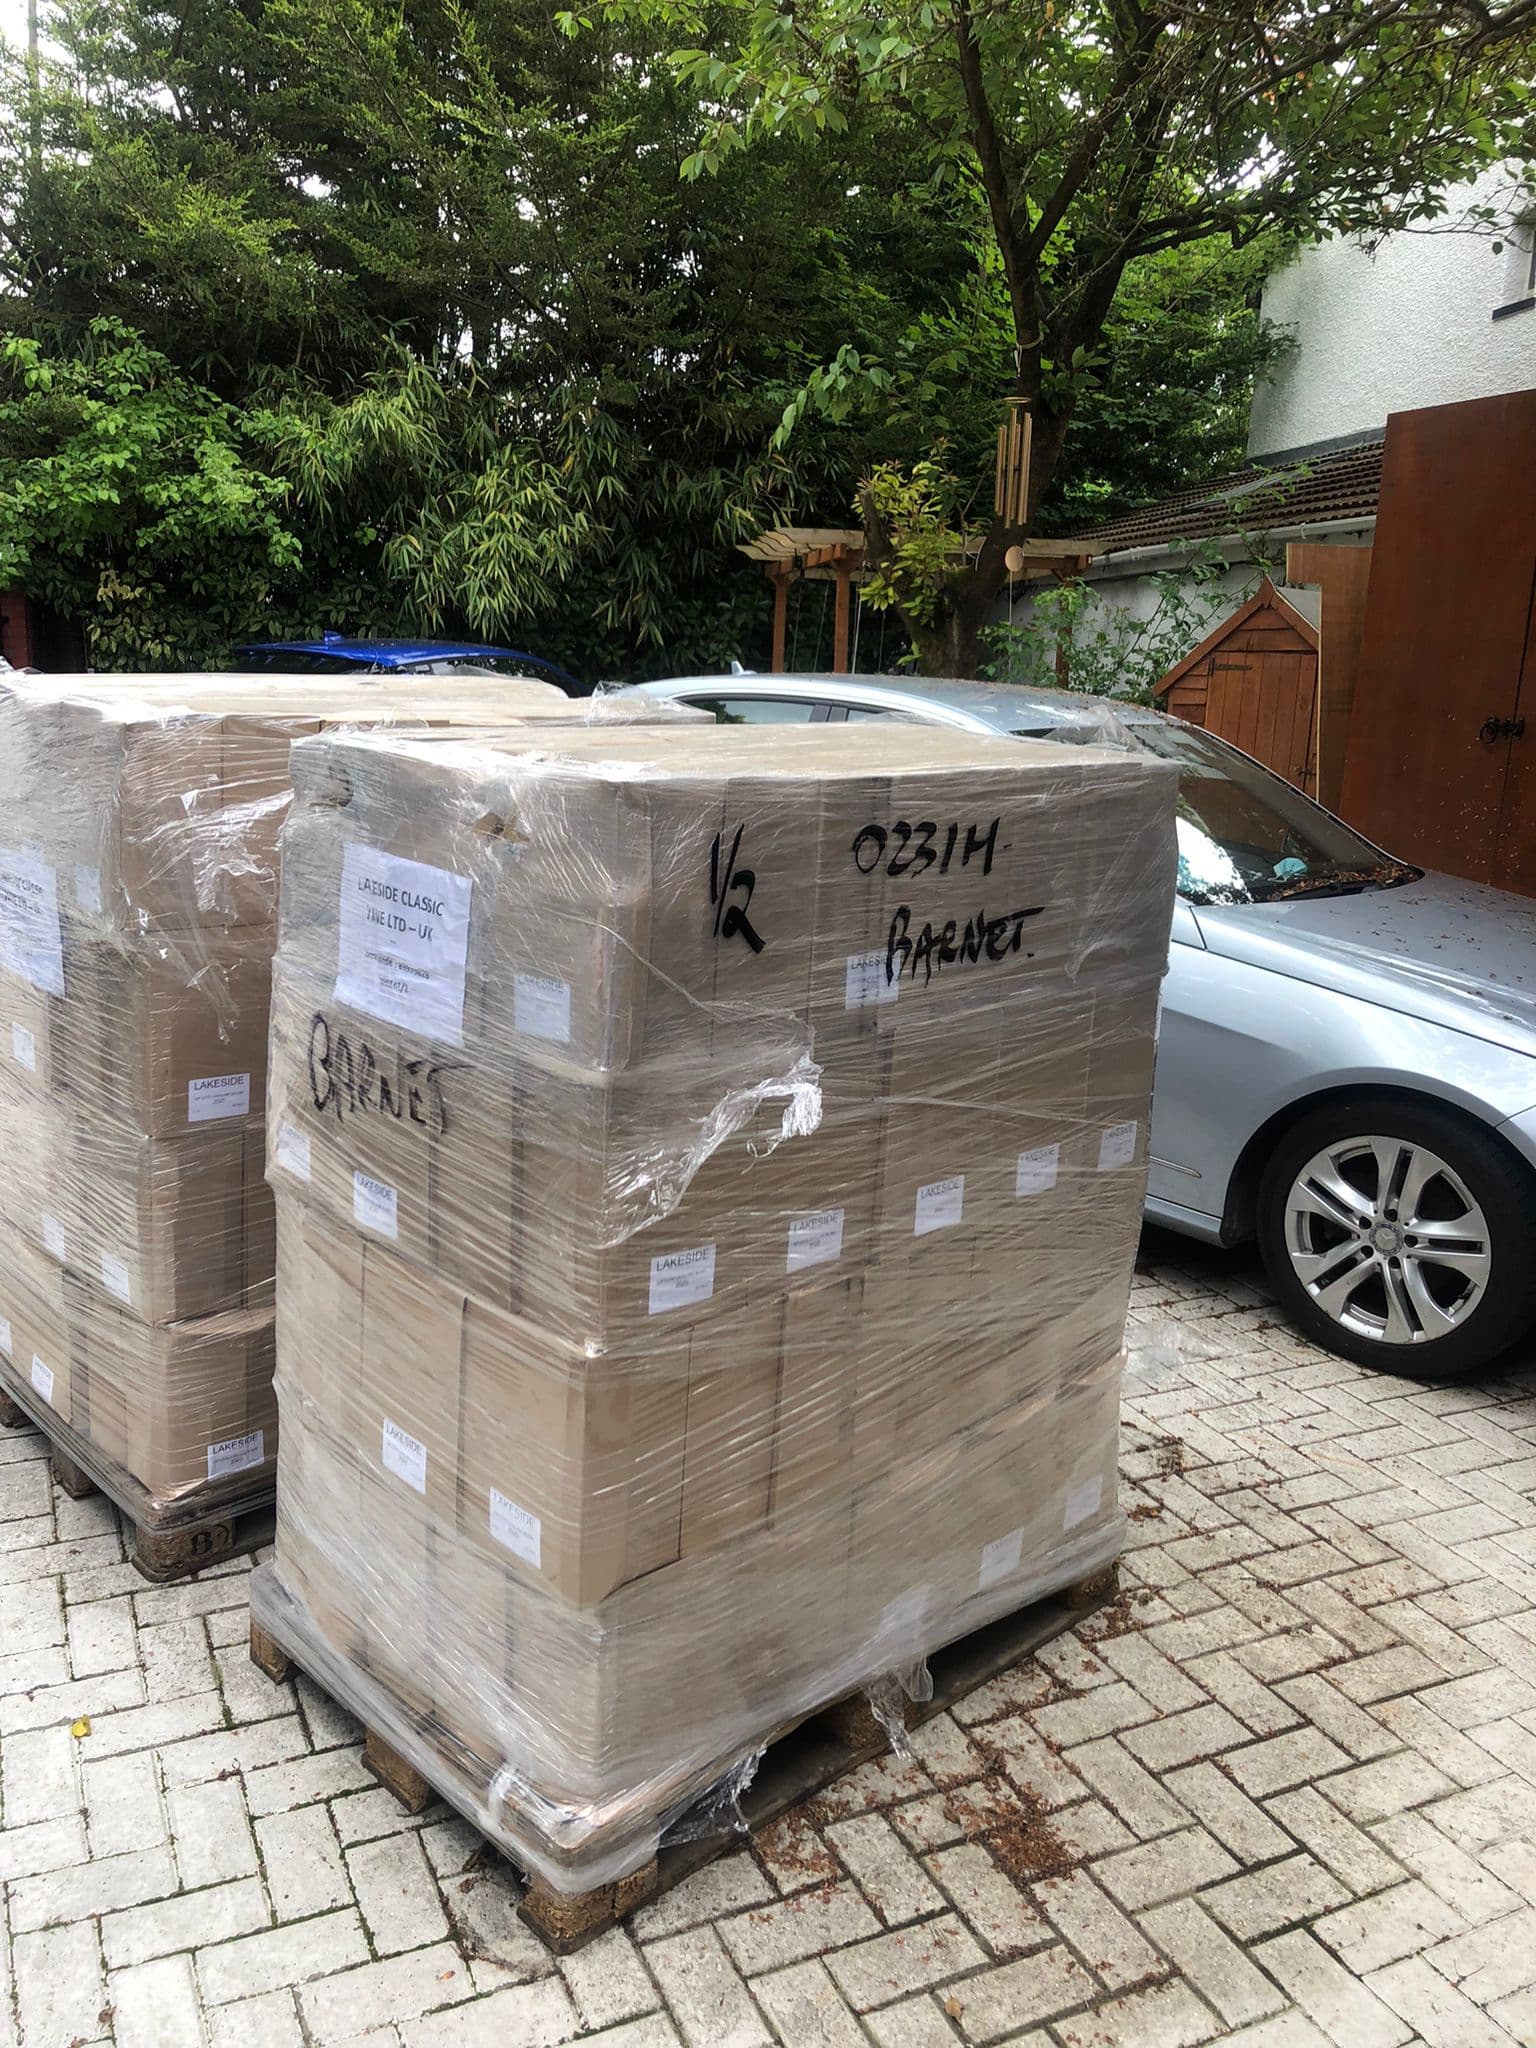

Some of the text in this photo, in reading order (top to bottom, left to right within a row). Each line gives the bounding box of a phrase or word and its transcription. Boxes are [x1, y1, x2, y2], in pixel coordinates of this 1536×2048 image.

[710, 823, 767, 954] 1/2
[401, 891, 445, 917] CLASSIC
[387, 911, 406, 932] LTD
[851, 952, 895, 970] LAKESI
[194, 1076, 244, 1090] LAKESIDE
[309, 1012, 477, 1136] BARNET
[793, 1212, 838, 1232] LAKESIDE
[656, 1248, 710, 1271] LAKESIDE
[212, 1433, 258, 1455] LAKESIDE
